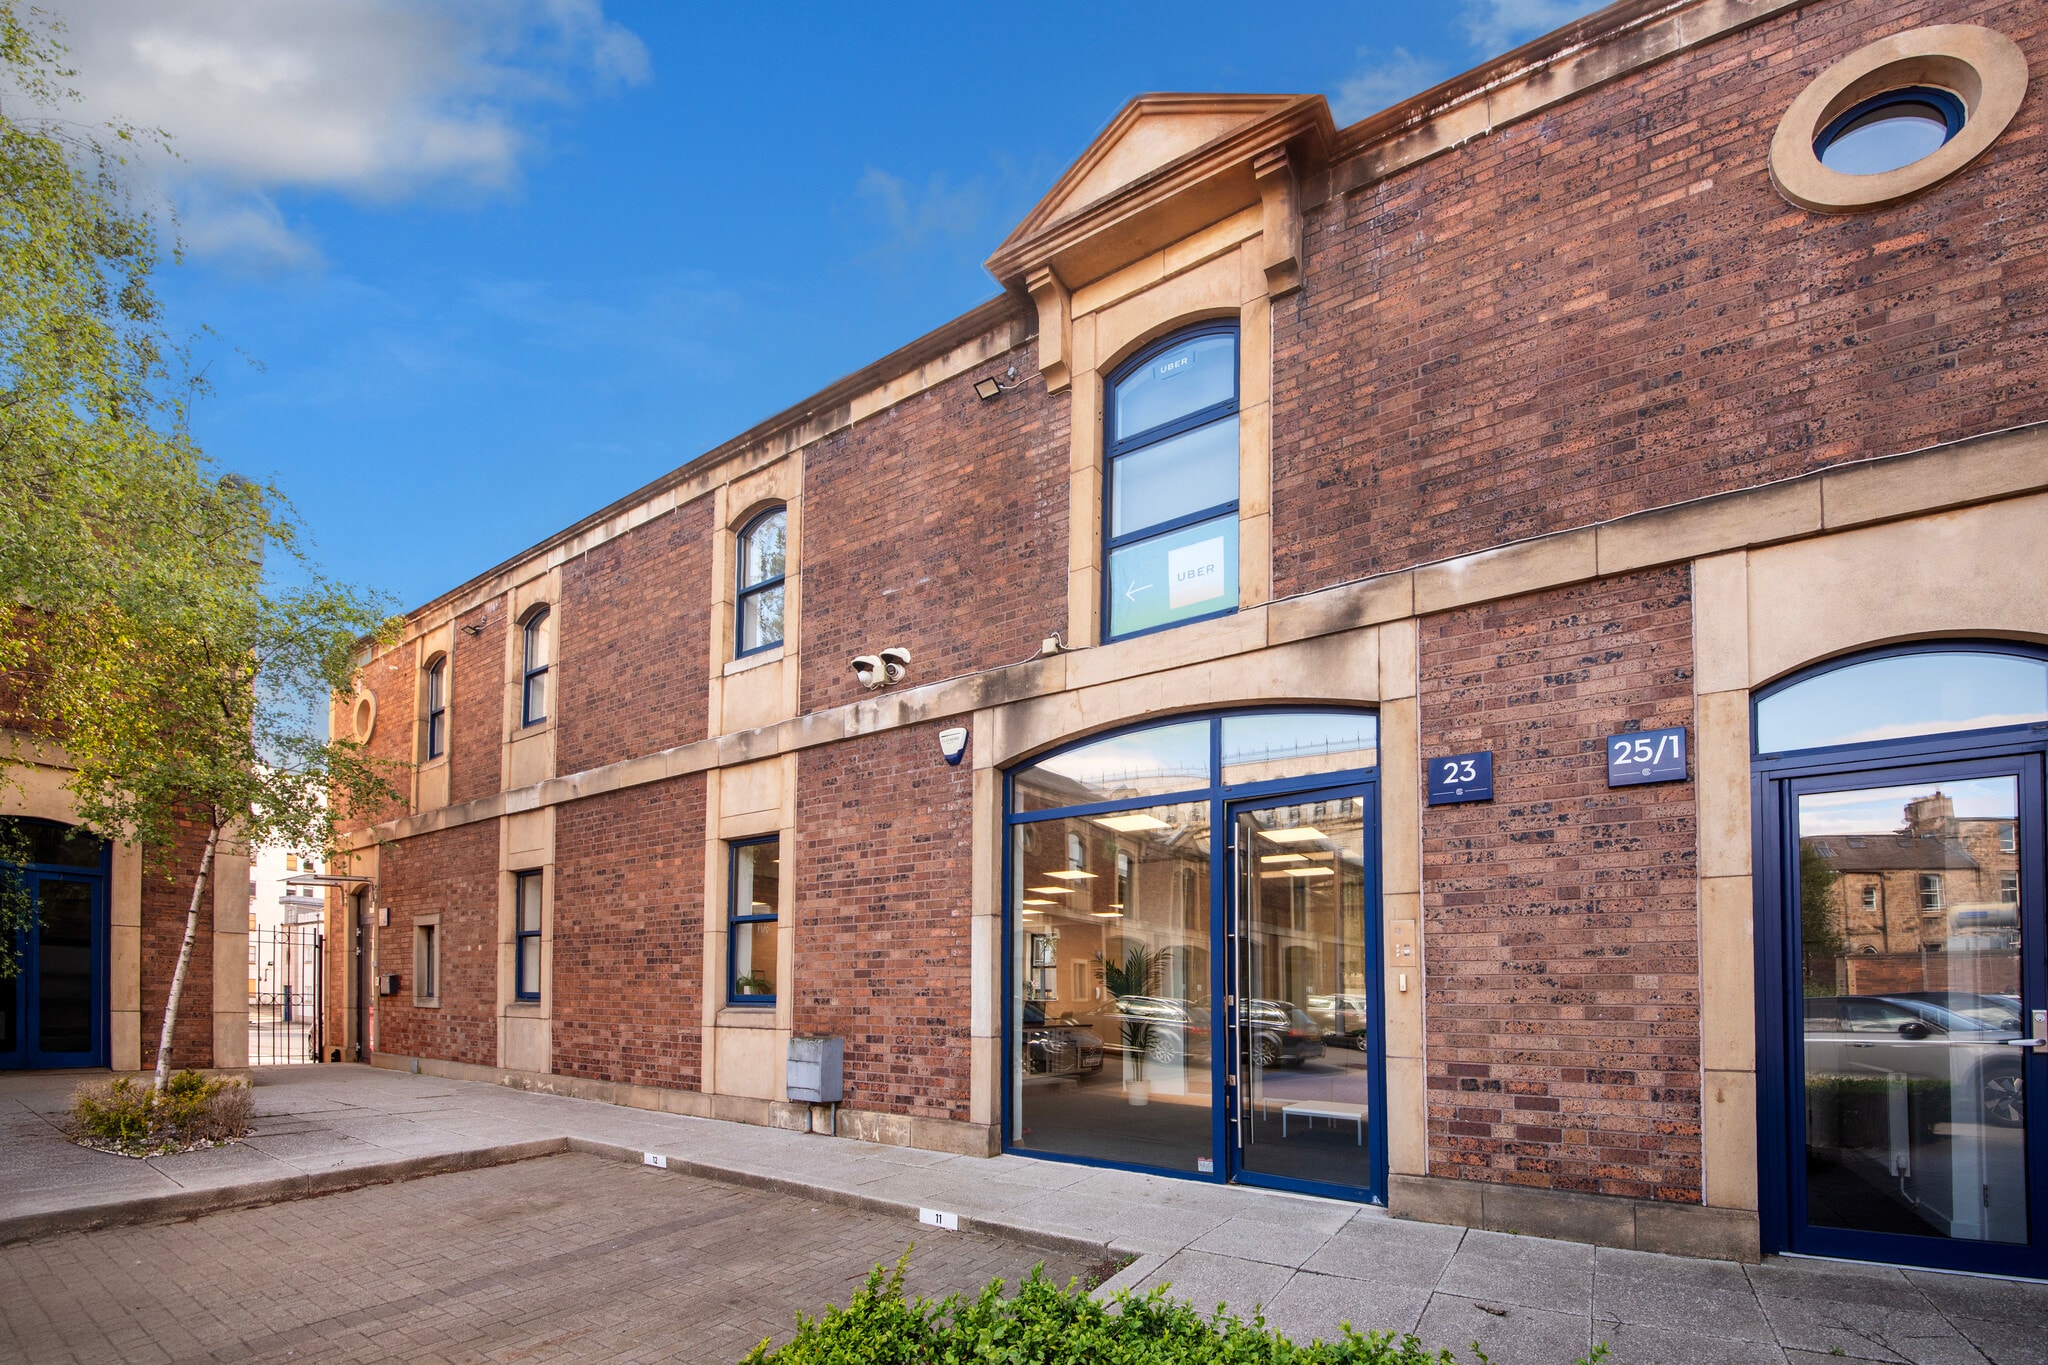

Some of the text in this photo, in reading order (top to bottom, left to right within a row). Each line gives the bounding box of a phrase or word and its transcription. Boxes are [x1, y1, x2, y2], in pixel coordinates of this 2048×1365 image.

[1160, 357, 1188, 373] UBER
[1177, 564, 1215, 581] UBER
[1613, 735, 1679, 765] 25/1
[1443, 760, 1476, 784] 23
[652, 1155, 658, 1165] 12
[935, 1213, 942, 1224] 11
